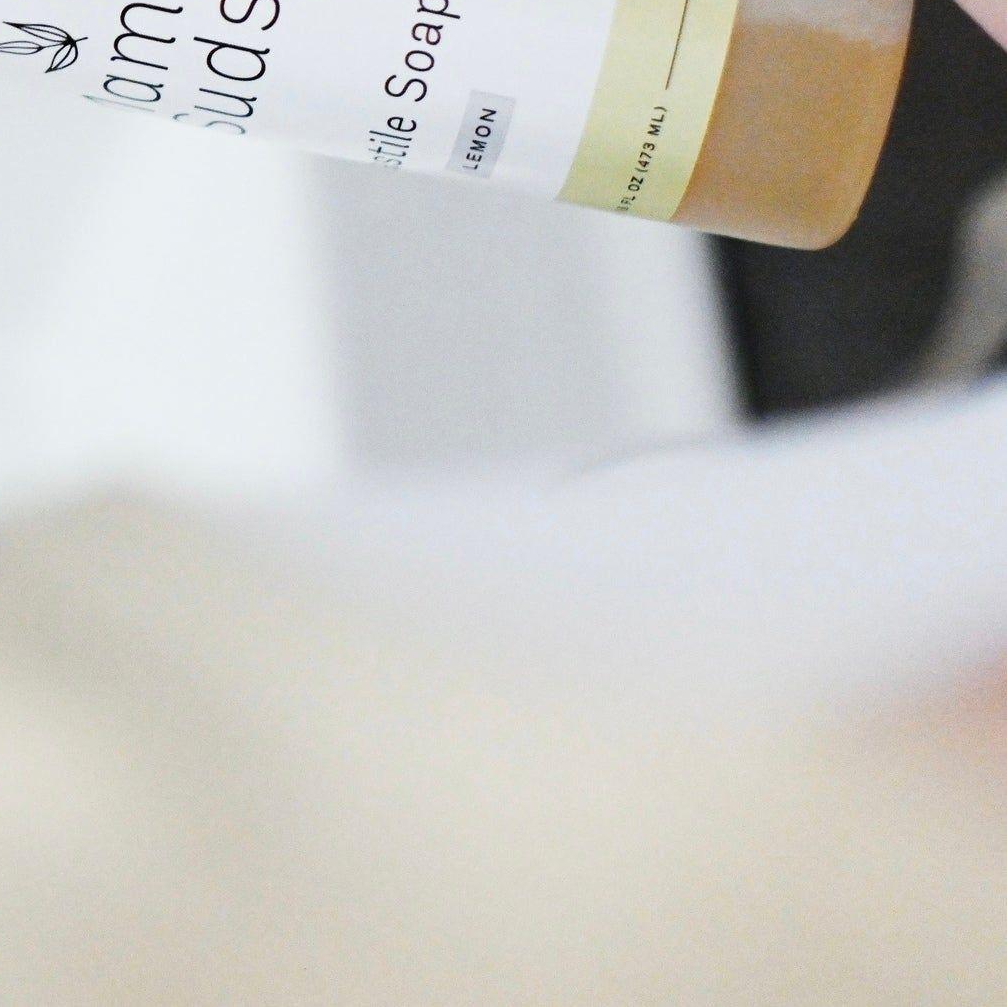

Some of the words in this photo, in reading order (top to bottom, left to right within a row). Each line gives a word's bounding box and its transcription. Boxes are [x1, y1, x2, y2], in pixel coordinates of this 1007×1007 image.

[647, 106, 668, 136] ML)
[462, 108, 497, 170] LEMON
[634, 142, 655, 173] (473
[628, 176, 644, 192] OZ
